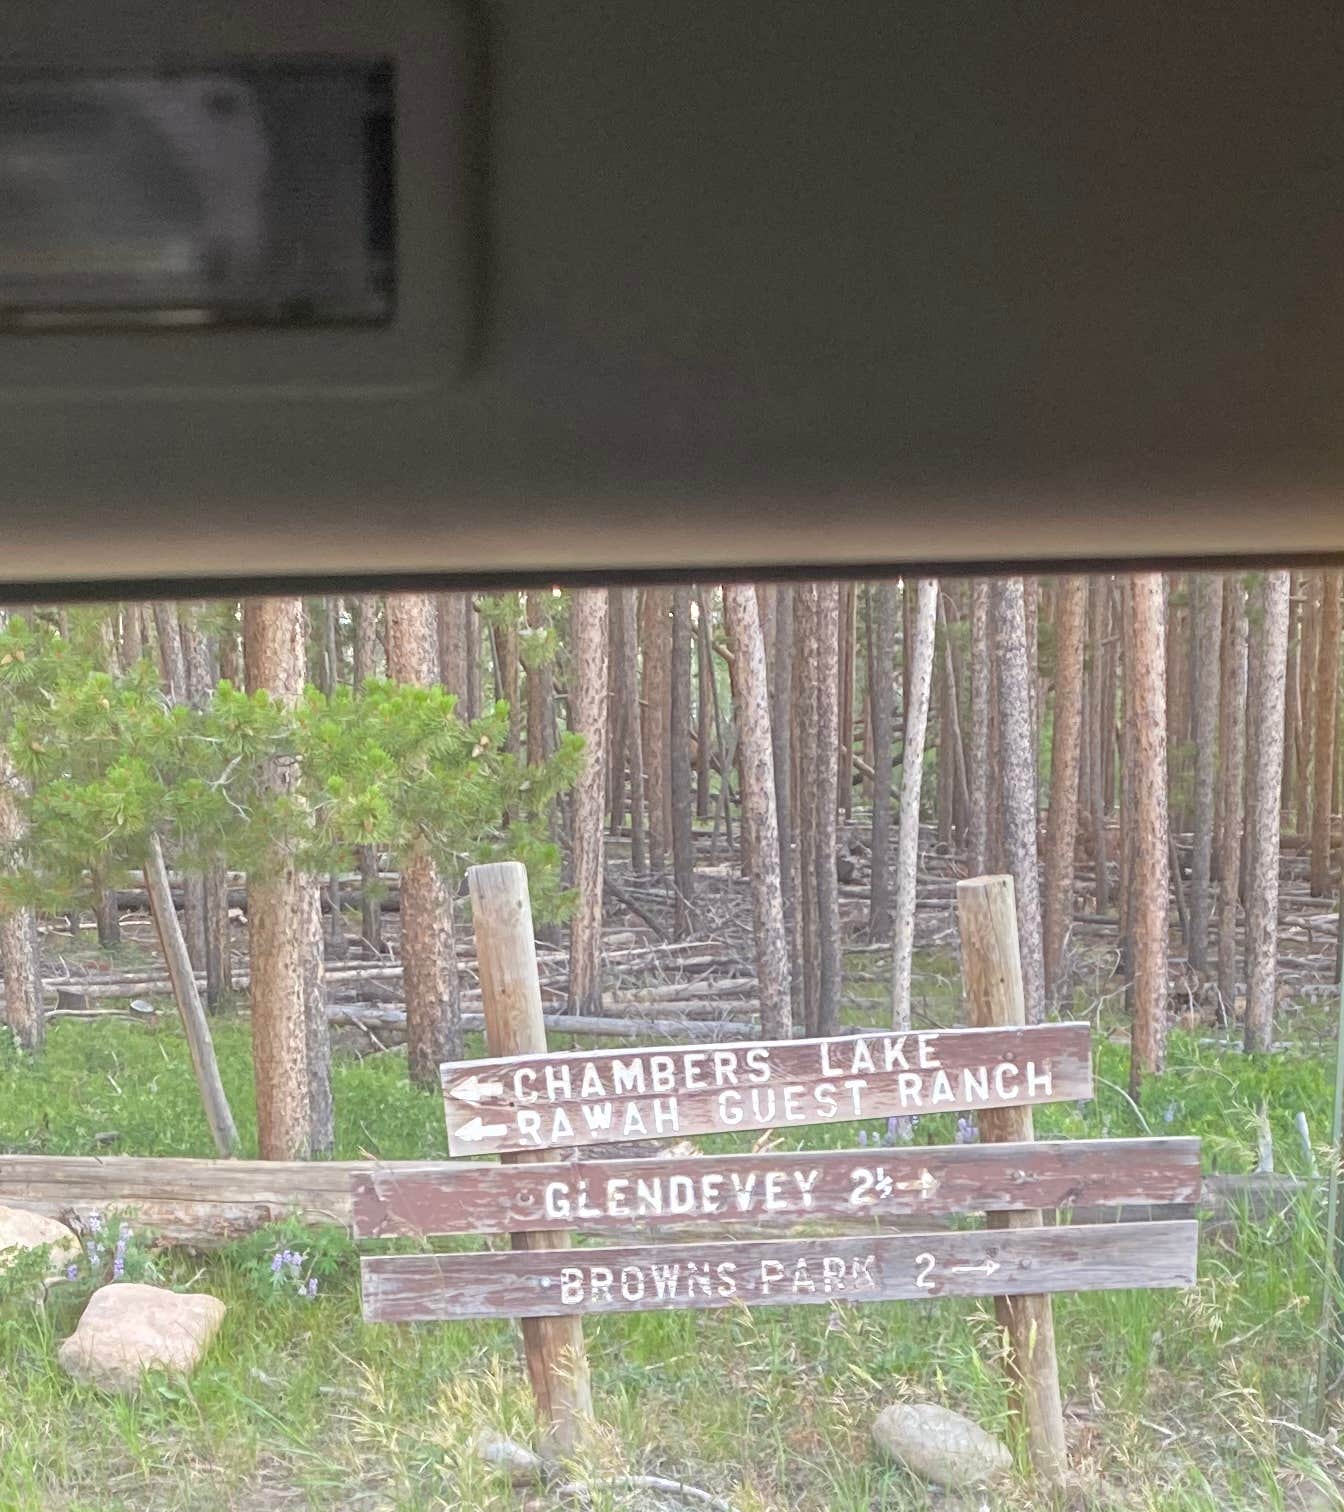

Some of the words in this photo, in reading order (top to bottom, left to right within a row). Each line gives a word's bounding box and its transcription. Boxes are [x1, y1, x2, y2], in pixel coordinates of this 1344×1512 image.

[513, 1048, 772, 1103] CHAMBERS
[818, 1034, 943, 1077] LAKE
[516, 1097, 679, 1145] RAWAH
[718, 1079, 868, 1126] GUEST
[897, 1057, 1053, 1108] RANCH
[545, 1169, 819, 1219] GLENDEVEY
[560, 1261, 738, 1305] BROWNS
[760, 1255, 877, 1296] PARK
[915, 1252, 937, 1289] 2
